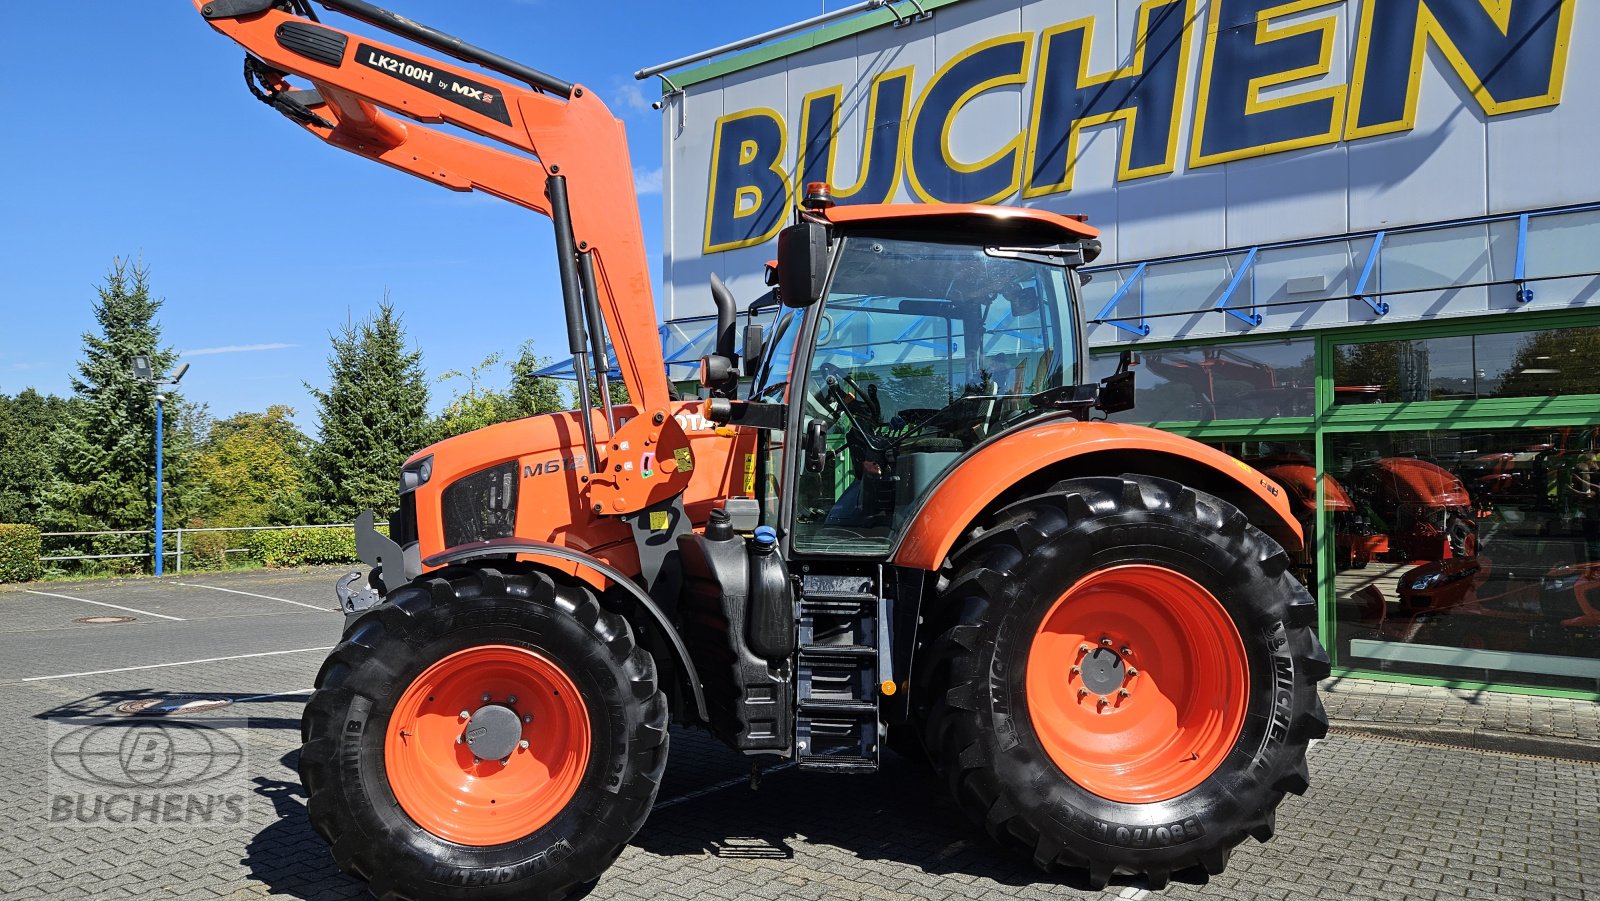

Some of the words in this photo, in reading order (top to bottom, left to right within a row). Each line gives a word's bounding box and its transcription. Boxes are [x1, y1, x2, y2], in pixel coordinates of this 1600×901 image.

[368, 51, 434, 84] LK2100H
[438, 79, 448, 90] by
[451, 81, 483, 101] MX
[703, 0, 1577, 254] BUCHEN
[1251, 655, 1294, 786] MICHELIN
